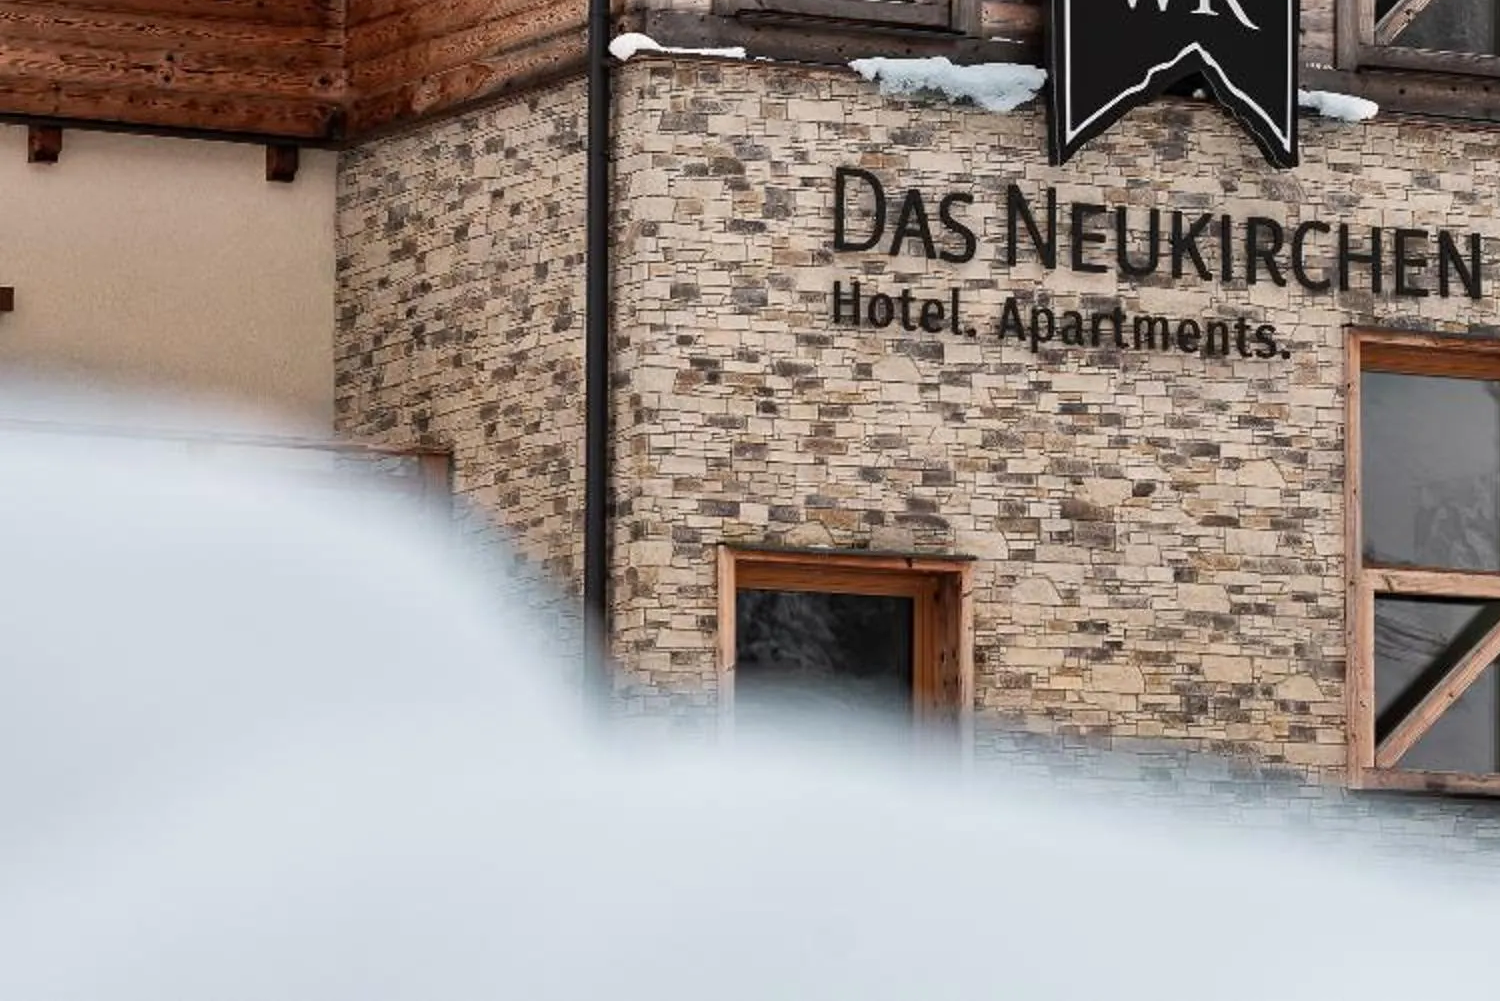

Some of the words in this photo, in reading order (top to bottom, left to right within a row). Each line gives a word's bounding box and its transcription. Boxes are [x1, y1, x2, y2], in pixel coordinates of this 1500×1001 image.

[834, 165, 976, 264] DAS
[1007, 184, 1483, 300] NEUKIRCHEN
[833, 279, 977, 339] Hotel.
[999, 294, 1292, 361] Apartments.
